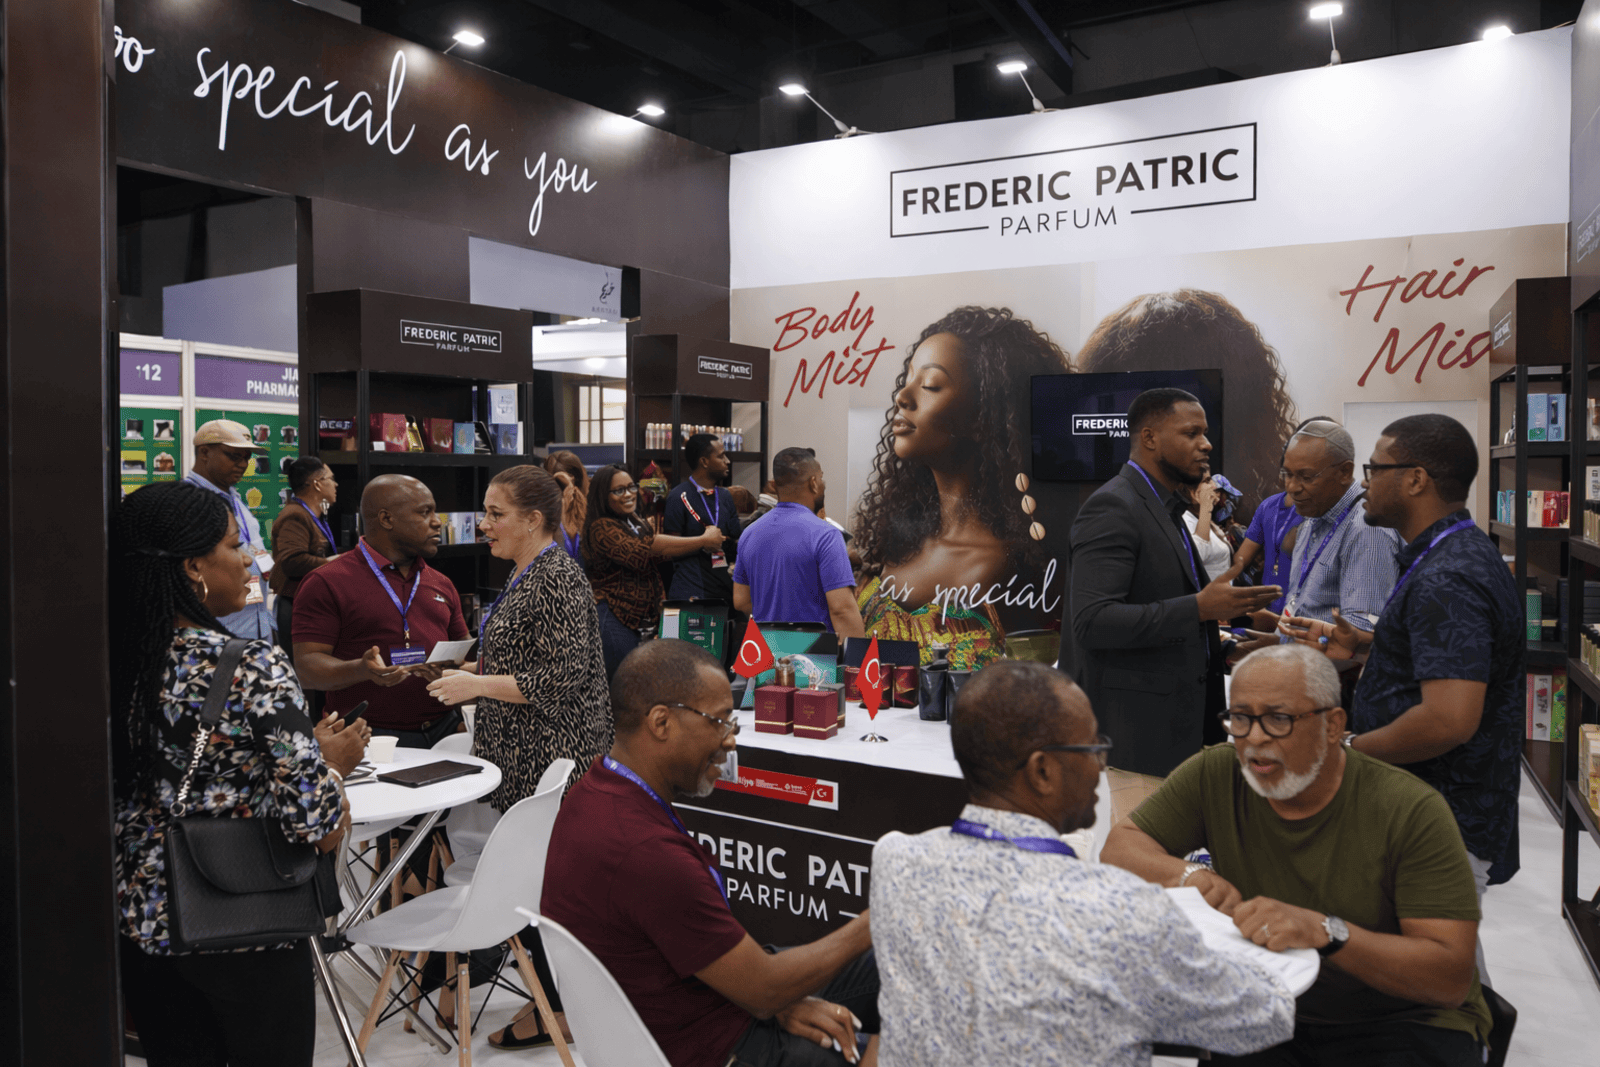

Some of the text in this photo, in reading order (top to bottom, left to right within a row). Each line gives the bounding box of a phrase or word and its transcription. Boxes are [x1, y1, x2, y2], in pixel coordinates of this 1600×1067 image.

[194, 47, 415, 154] special
[444, 123, 500, 175] as
[524, 151, 597, 236] you
[901, 148, 1240, 217] FREDERIC PATRIC
[1000, 205, 1118, 237] PARFUM
[774, 290, 874, 352] Body
[1339, 257, 1495, 323] Hair
[404, 326, 498, 347] FREDERIC PATRIC
[783, 337, 896, 408] Mist
[879, 558, 1061, 625] as special
[687, 830, 787, 880] DERIC
[726, 877, 829, 922] PARFUM
